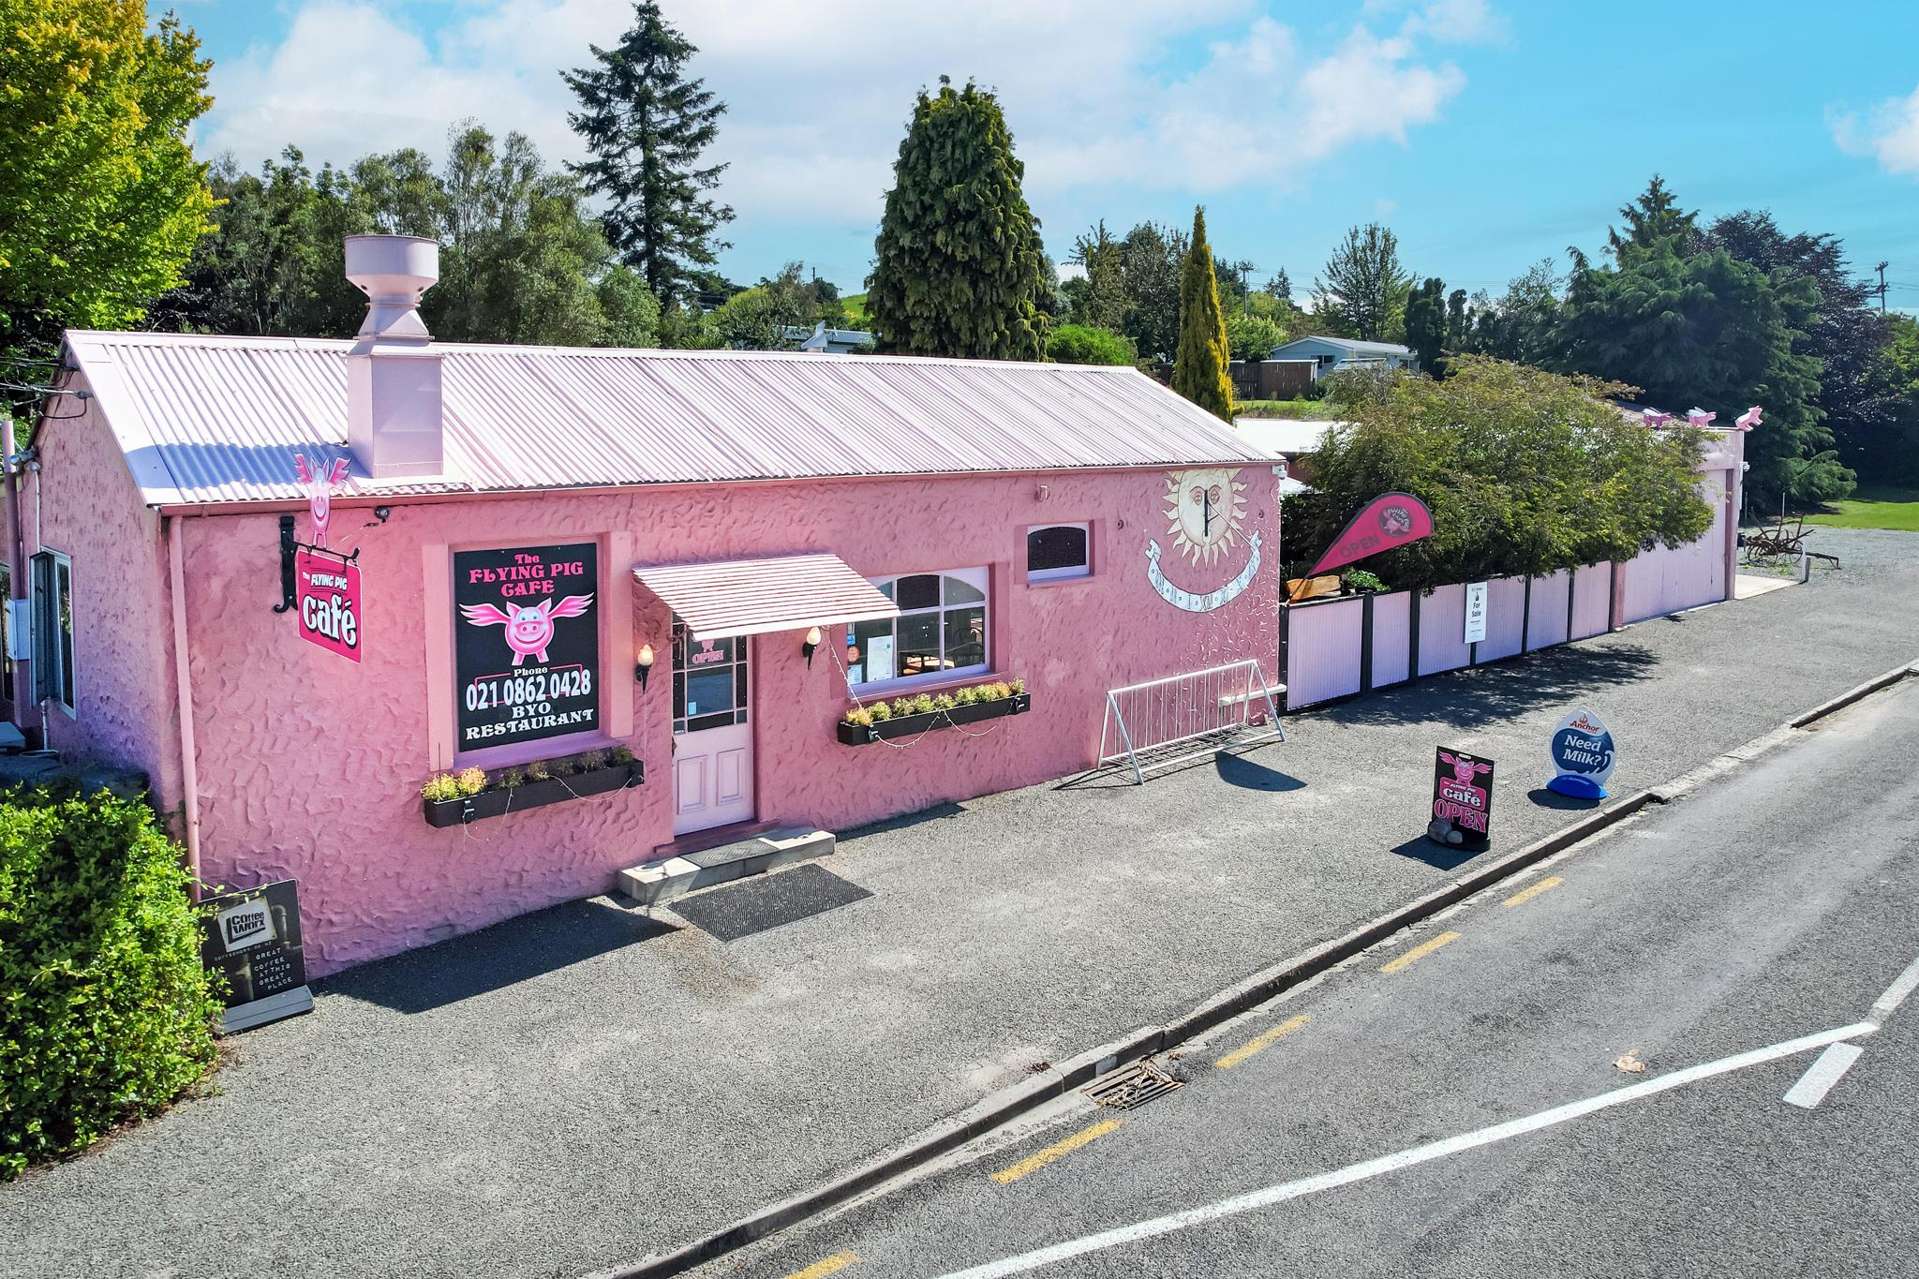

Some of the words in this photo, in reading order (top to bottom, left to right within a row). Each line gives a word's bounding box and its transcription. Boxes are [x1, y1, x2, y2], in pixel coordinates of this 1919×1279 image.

[514, 554, 540, 564] The
[469, 564, 545, 584] FLYING
[550, 562, 584, 576] PIG
[311, 573, 334, 587] FLYING
[334, 575, 348, 591] PIG
[501, 580, 555, 598] CAFE
[514, 666, 548, 677] Phone
[466, 681, 498, 712] 021
[504, 674, 546, 706] 0862
[550, 669, 591, 700] 0428
[512, 702, 550, 719] BYO
[466, 708, 594, 740] RESTAURANT
[1570, 720, 1600, 732] Anchor
[1564, 734, 1602, 752] Need
[1562, 749, 1601, 766] Milk?
[1434, 798, 1488, 833] OPEN
[256, 948, 281, 960] GREAT
[254, 956, 285, 972] COFFEE
[259, 972, 284, 986] GREAT
[268, 977, 292, 990] PLACE
